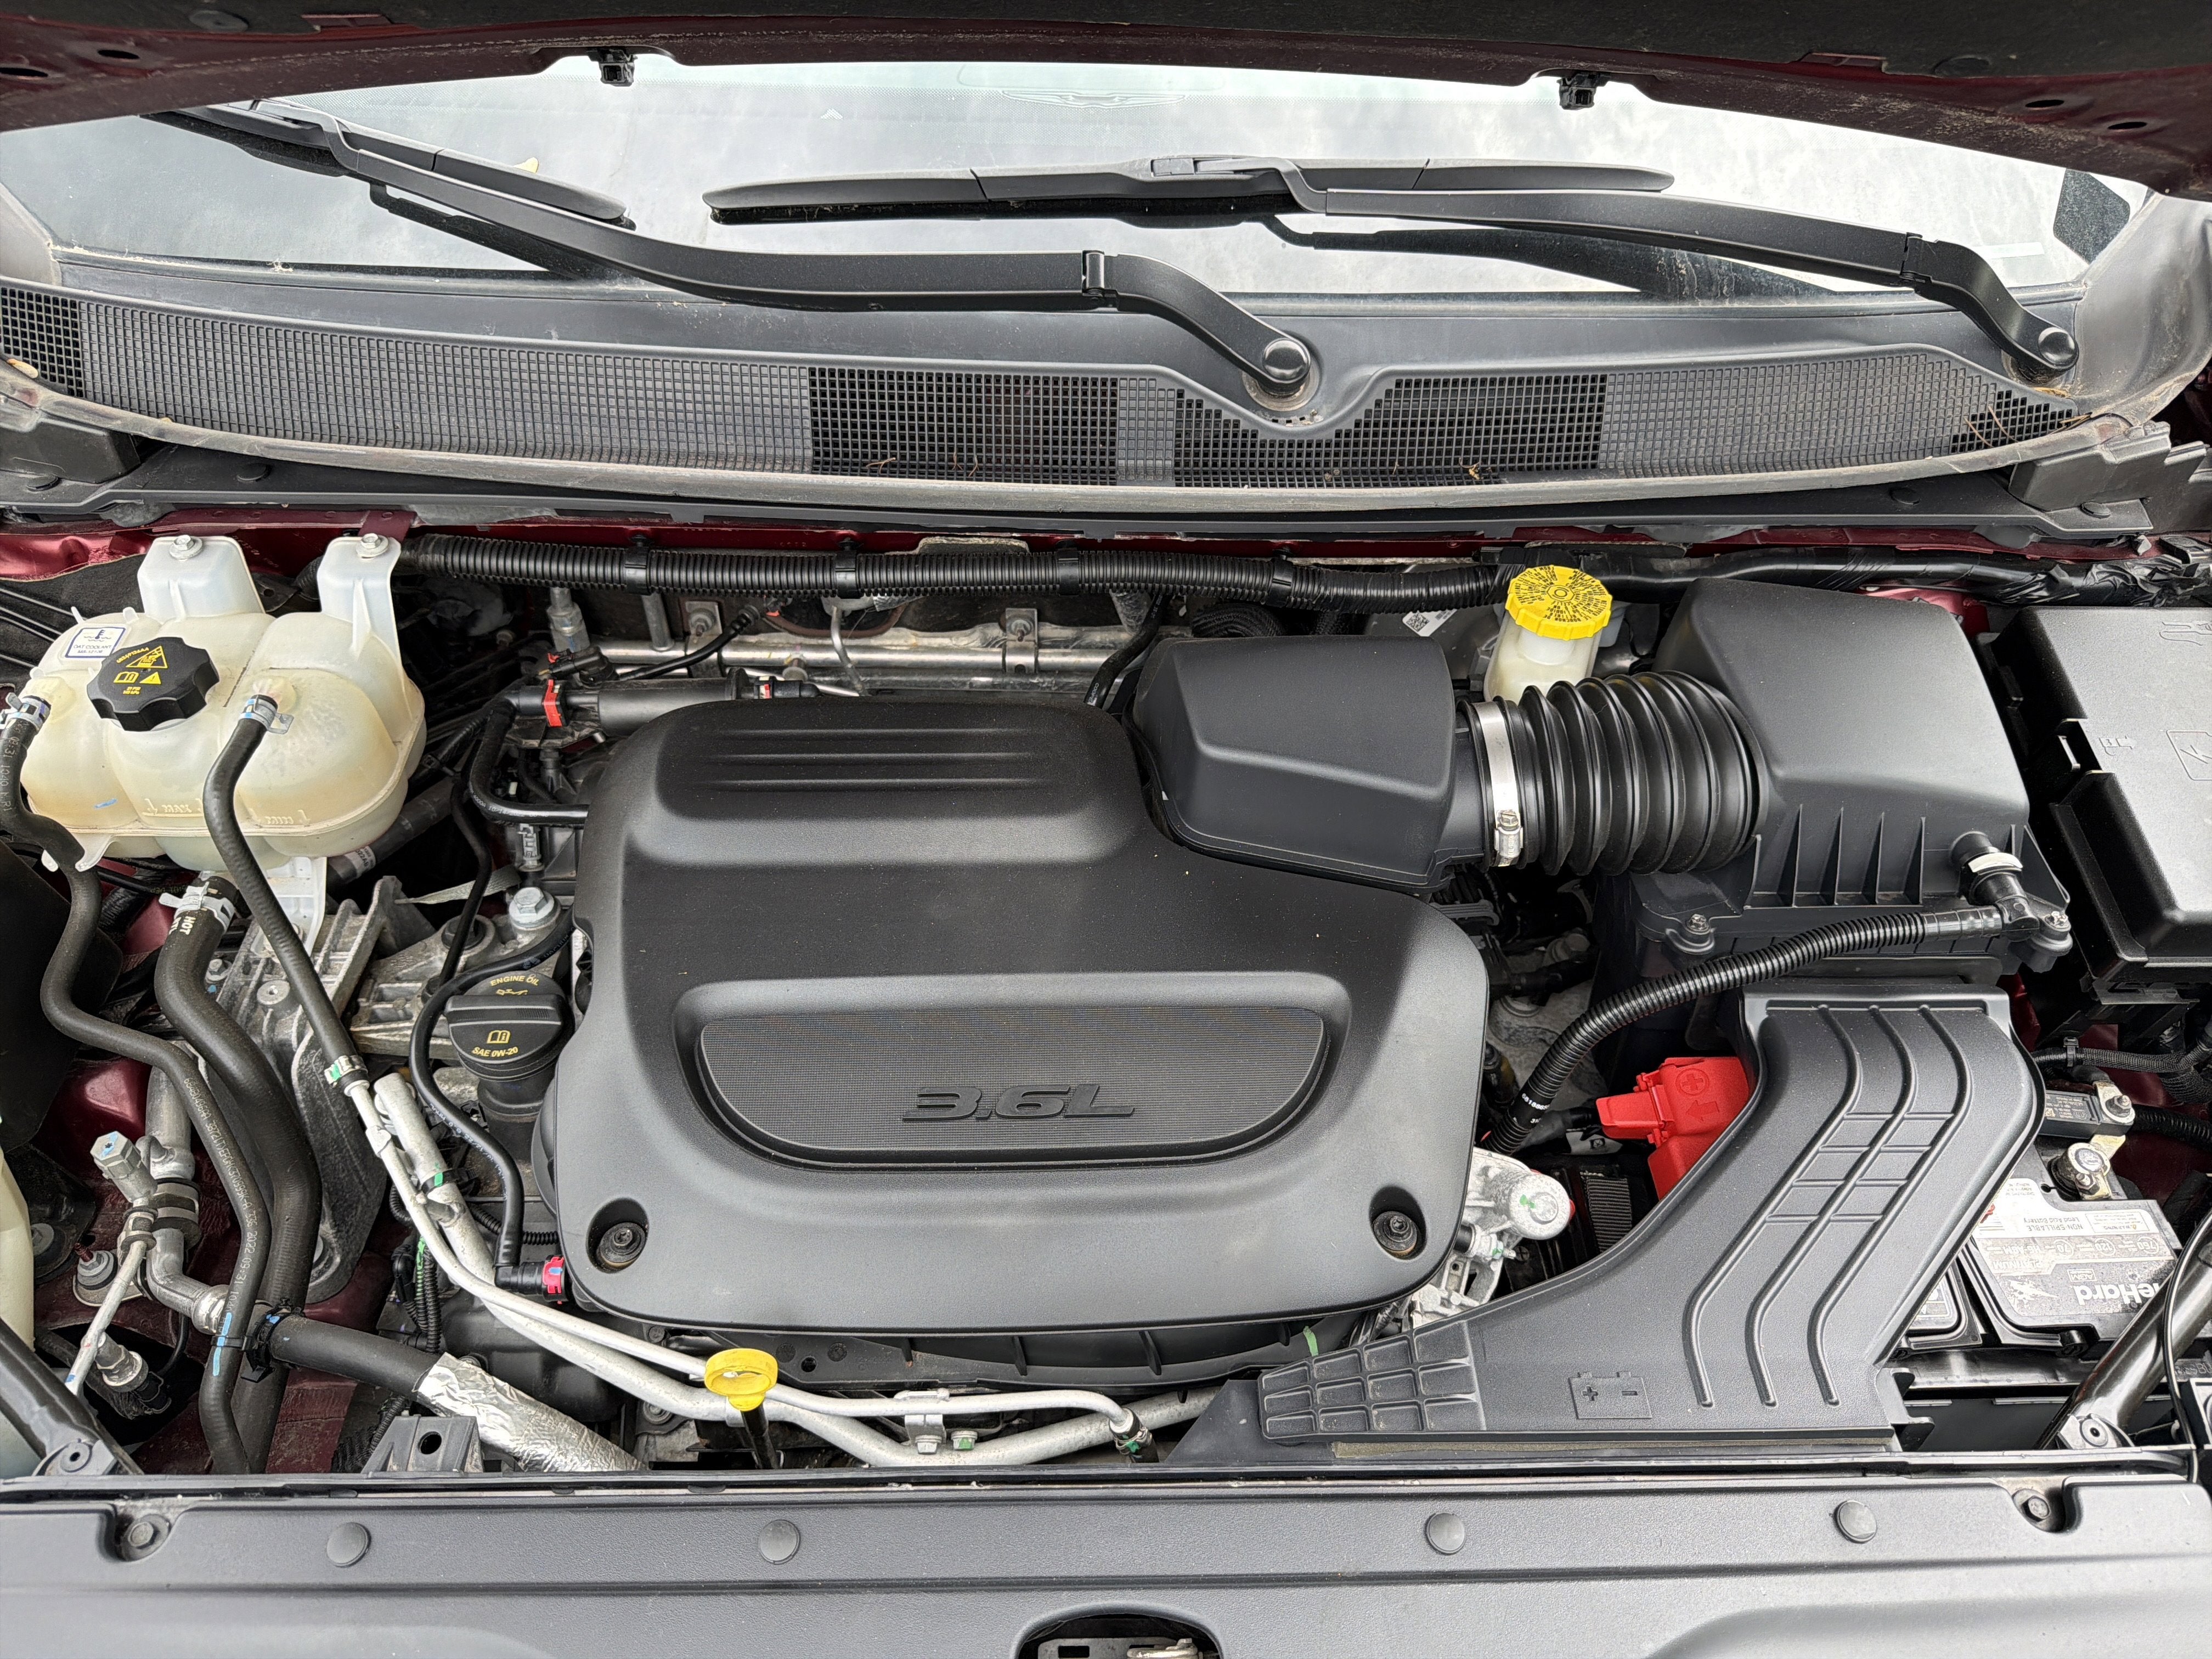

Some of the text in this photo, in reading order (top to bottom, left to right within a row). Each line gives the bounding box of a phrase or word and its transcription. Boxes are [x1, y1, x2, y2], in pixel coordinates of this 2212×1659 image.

[181, 916, 195, 935] HOT
[490, 975, 540, 986] ENGINE OIL
[472, 1047, 518, 1057] SAE 0W-20
[901, 1083, 1136, 1122] 3.6L
[2026, 1223, 2083, 1231] NON-SPILLABLE
[244, 1231, 257, 1254] 2022
[2094, 1243, 2113, 1251] 120
[2136, 1241, 2156, 1250] 760
[2056, 1244, 2070, 1253] 70
[1993, 1260, 2043, 1269] PLATINUM
[234, 1257, 251, 1284] 09:31
[2073, 1283, 2159, 1306] eHard
